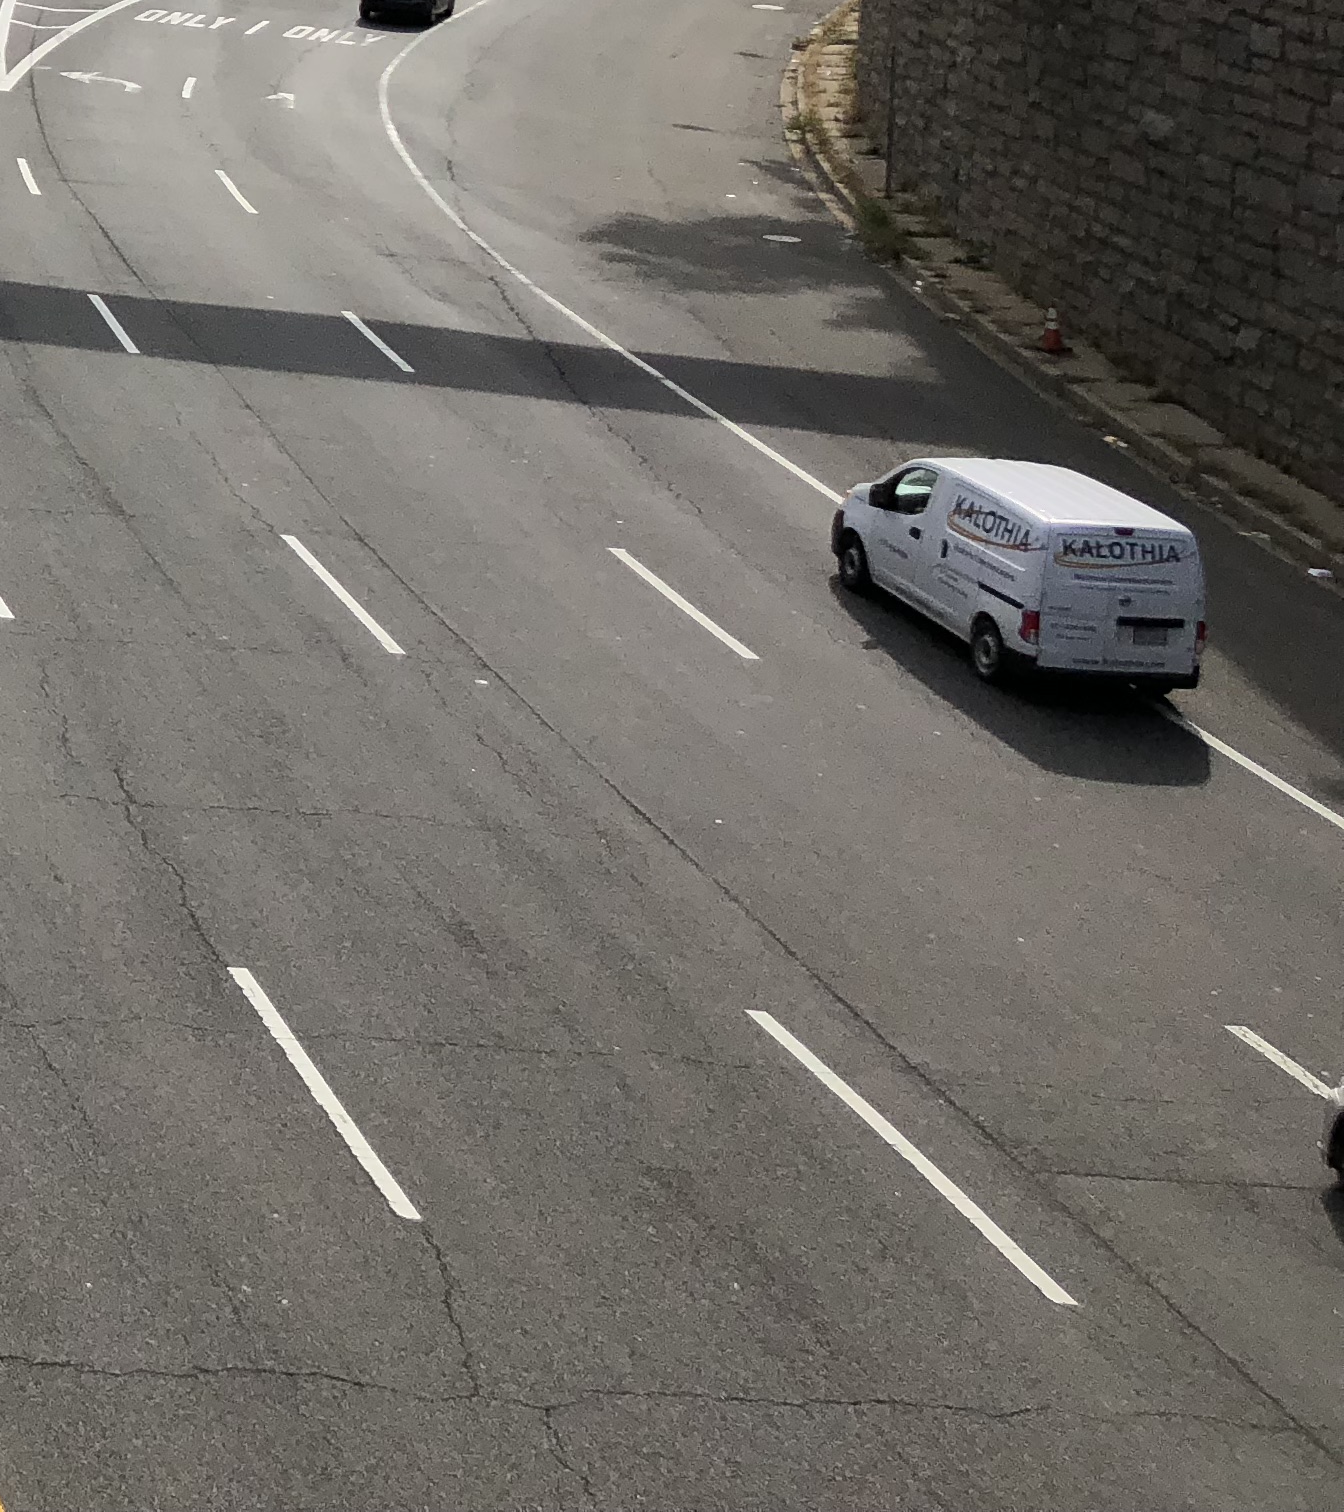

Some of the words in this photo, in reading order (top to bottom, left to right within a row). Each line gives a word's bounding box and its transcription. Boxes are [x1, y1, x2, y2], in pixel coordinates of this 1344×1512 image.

[133, 8, 236, 30] ONLY
[282, 24, 386, 48] ONLY
[953, 494, 1032, 547] KALOTHIA
[1061, 538, 1181, 563] KALOTHIA
